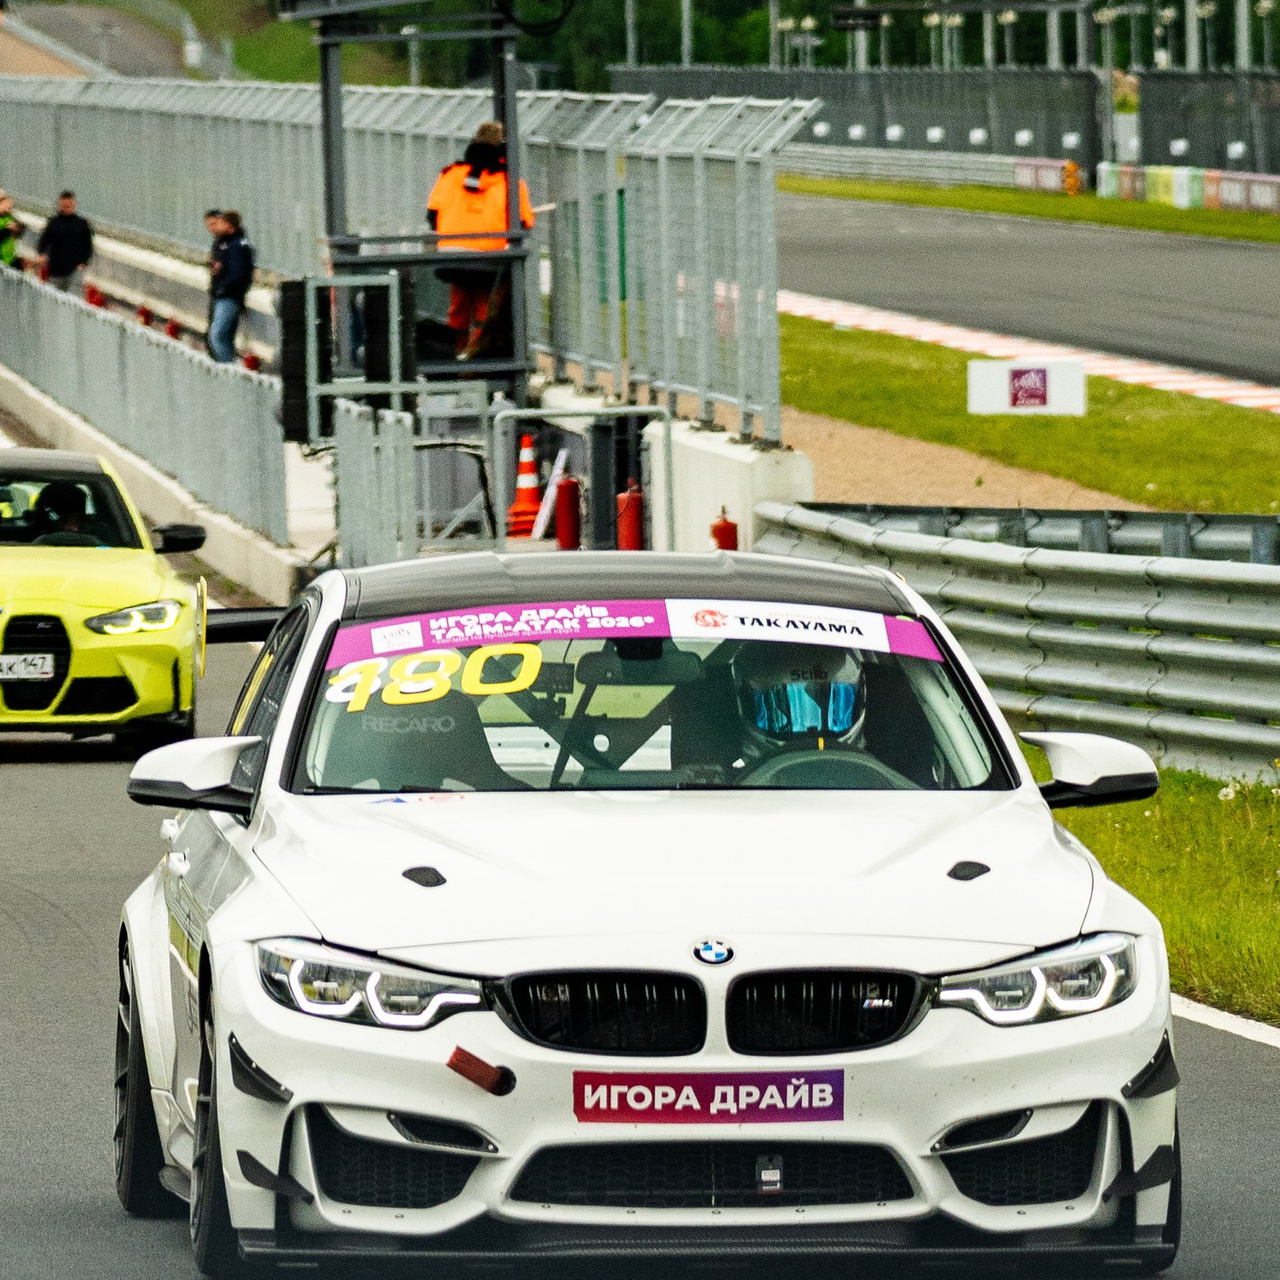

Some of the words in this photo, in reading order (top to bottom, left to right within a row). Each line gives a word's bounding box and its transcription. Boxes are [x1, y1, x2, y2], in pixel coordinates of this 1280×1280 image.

[429, 610, 514, 630] ИГОРА
[519, 604, 610, 622] ДРАЙВ
[734, 615, 864, 636] TAKAYAMA
[429, 618, 581, 641] ТАЙМ-АТАК
[583, 1083, 701, 1111] ИГОРА
[709, 1077, 834, 1115] ДРАЙВ
